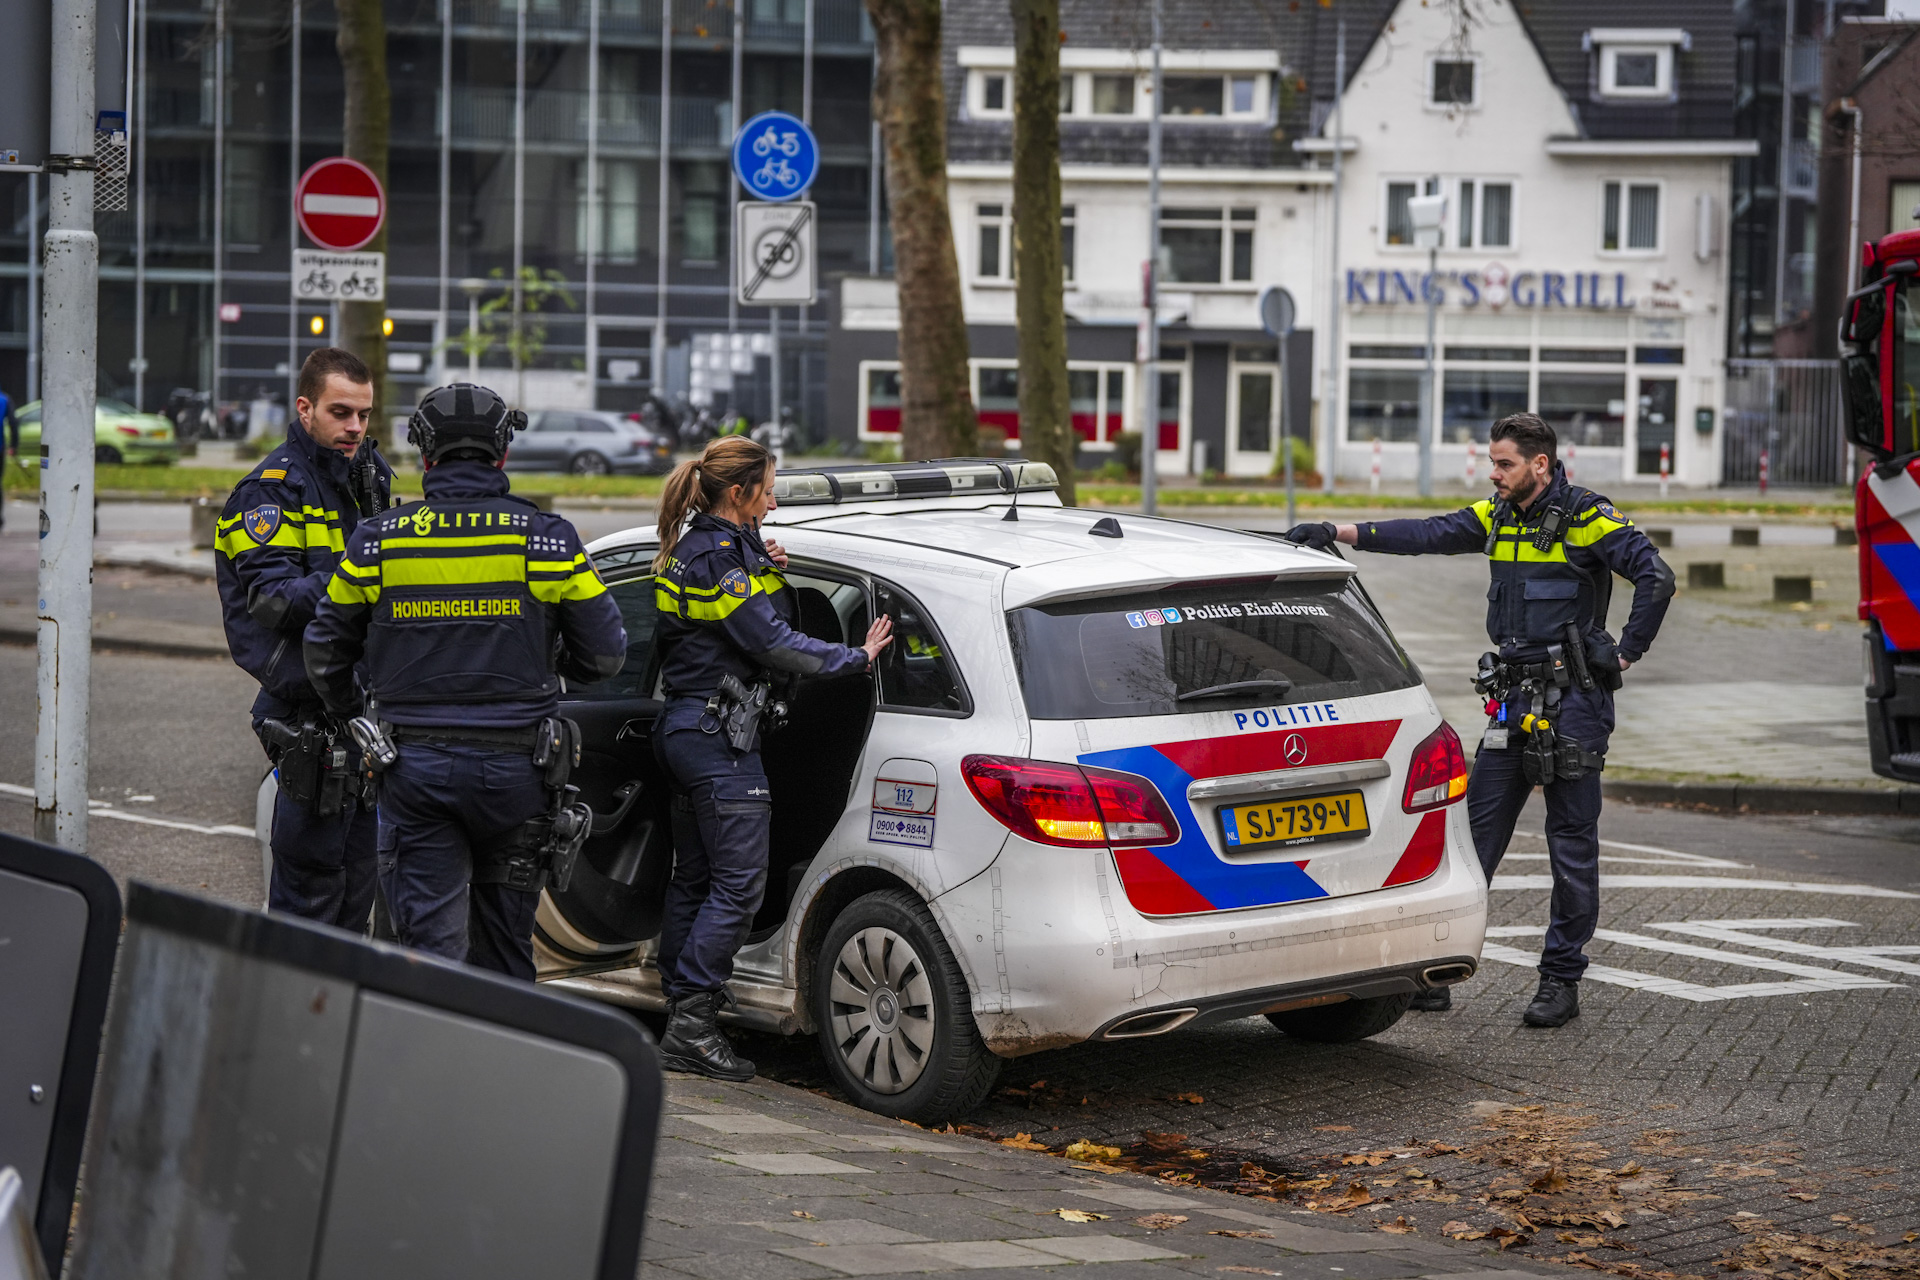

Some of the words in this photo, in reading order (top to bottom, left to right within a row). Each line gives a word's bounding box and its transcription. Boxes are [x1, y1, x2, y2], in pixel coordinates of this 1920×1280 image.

[764, 243, 794, 264] 30
[1346, 268, 1480, 307] KING'S
[1511, 269, 1636, 309] GRILL
[392, 599, 521, 618] HONDENGELEIDER
[1181, 604, 1242, 621] Politie
[1241, 602, 1329, 617] Eindhoven
[1233, 704, 1340, 731] POLITIE
[876, 819, 896, 832] 0900
[905, 823, 927, 836] 8844
[1247, 799, 1350, 839] SJ-739-V
[1226, 831, 1238, 841] NL
[1285, 836, 1315, 846] www.politie.nl
